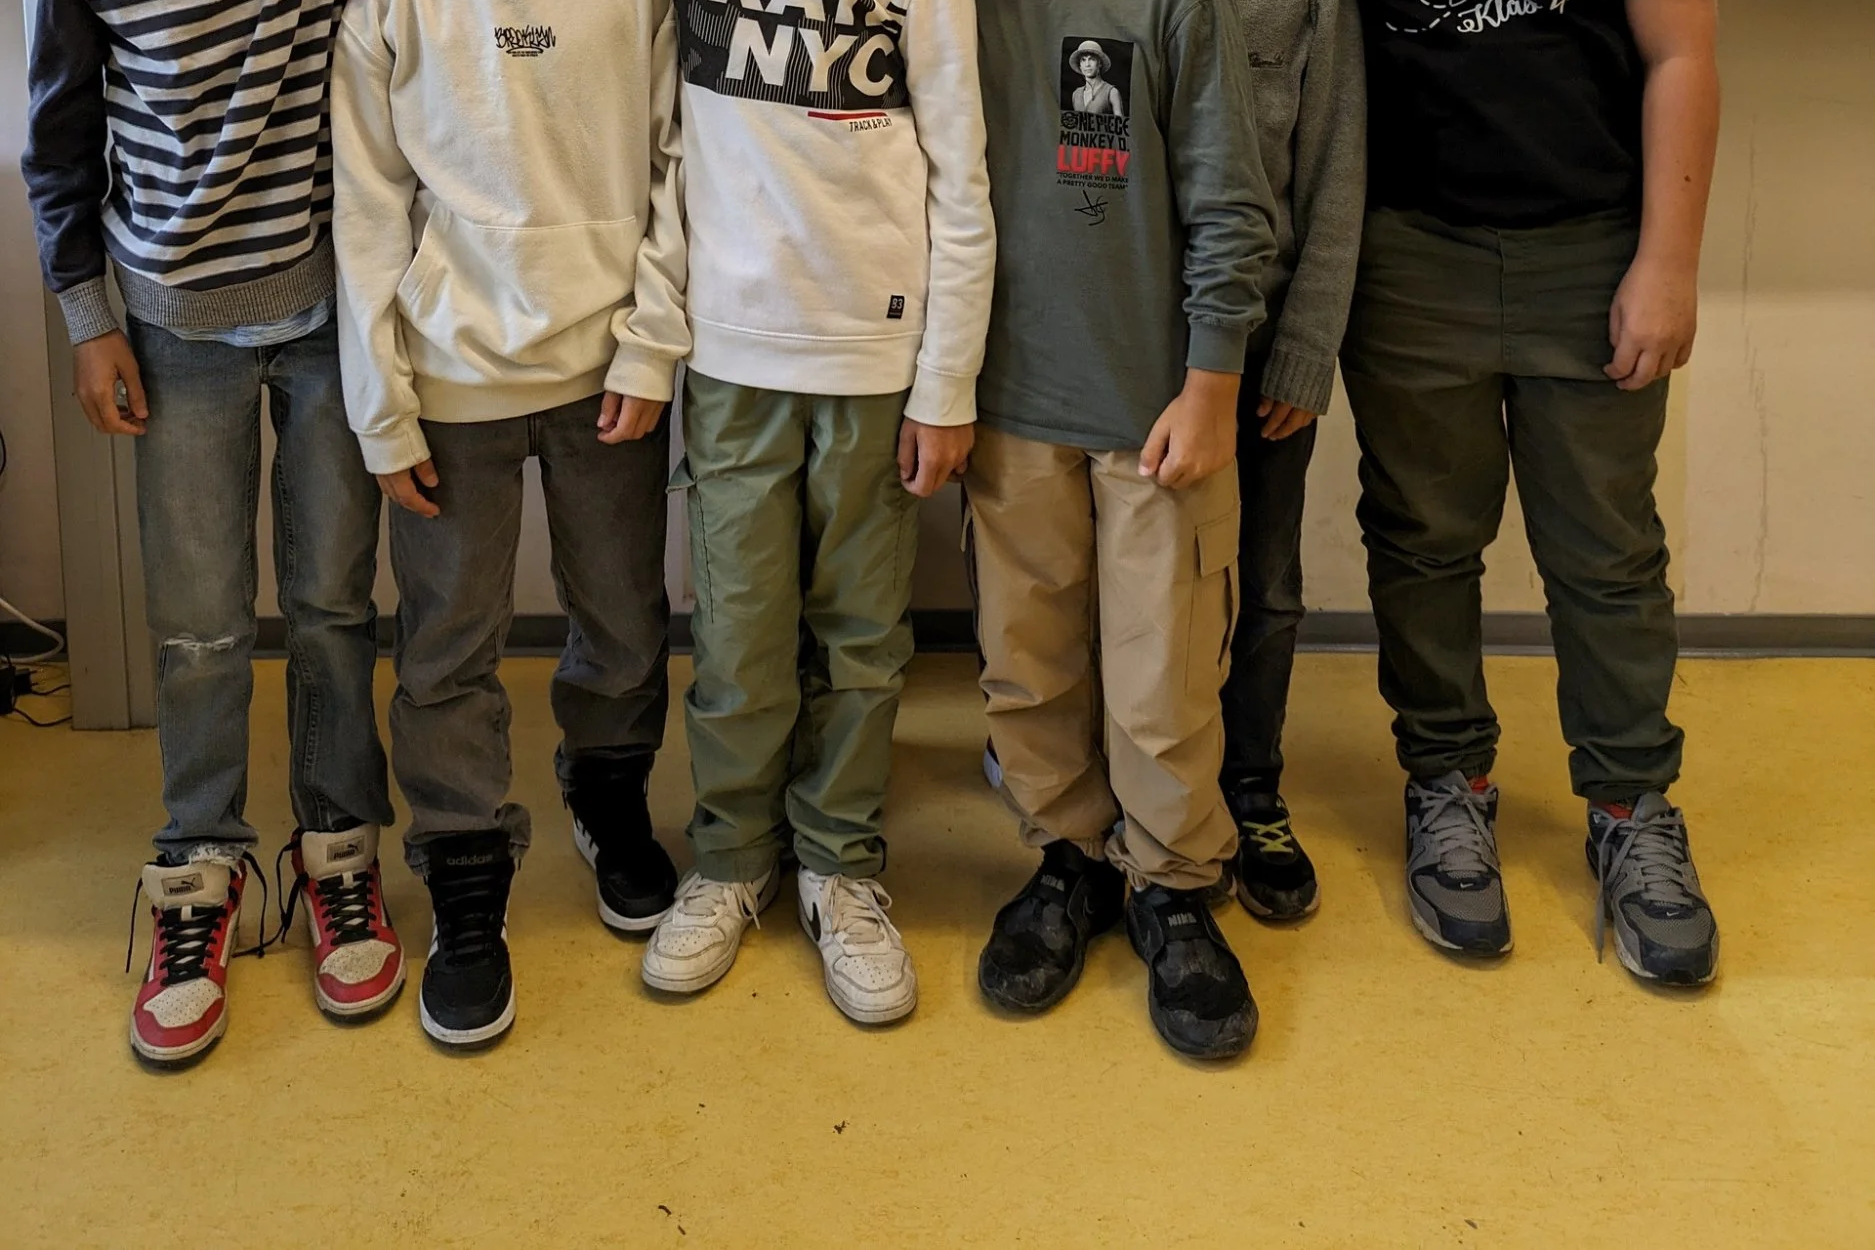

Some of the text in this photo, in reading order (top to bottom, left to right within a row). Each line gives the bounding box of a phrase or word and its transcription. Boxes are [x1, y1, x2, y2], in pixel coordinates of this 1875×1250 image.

[725, 17, 895, 97] NYC
[1059, 130, 1114, 149] MONKEY
[1056, 144, 1130, 176] LUFFY
